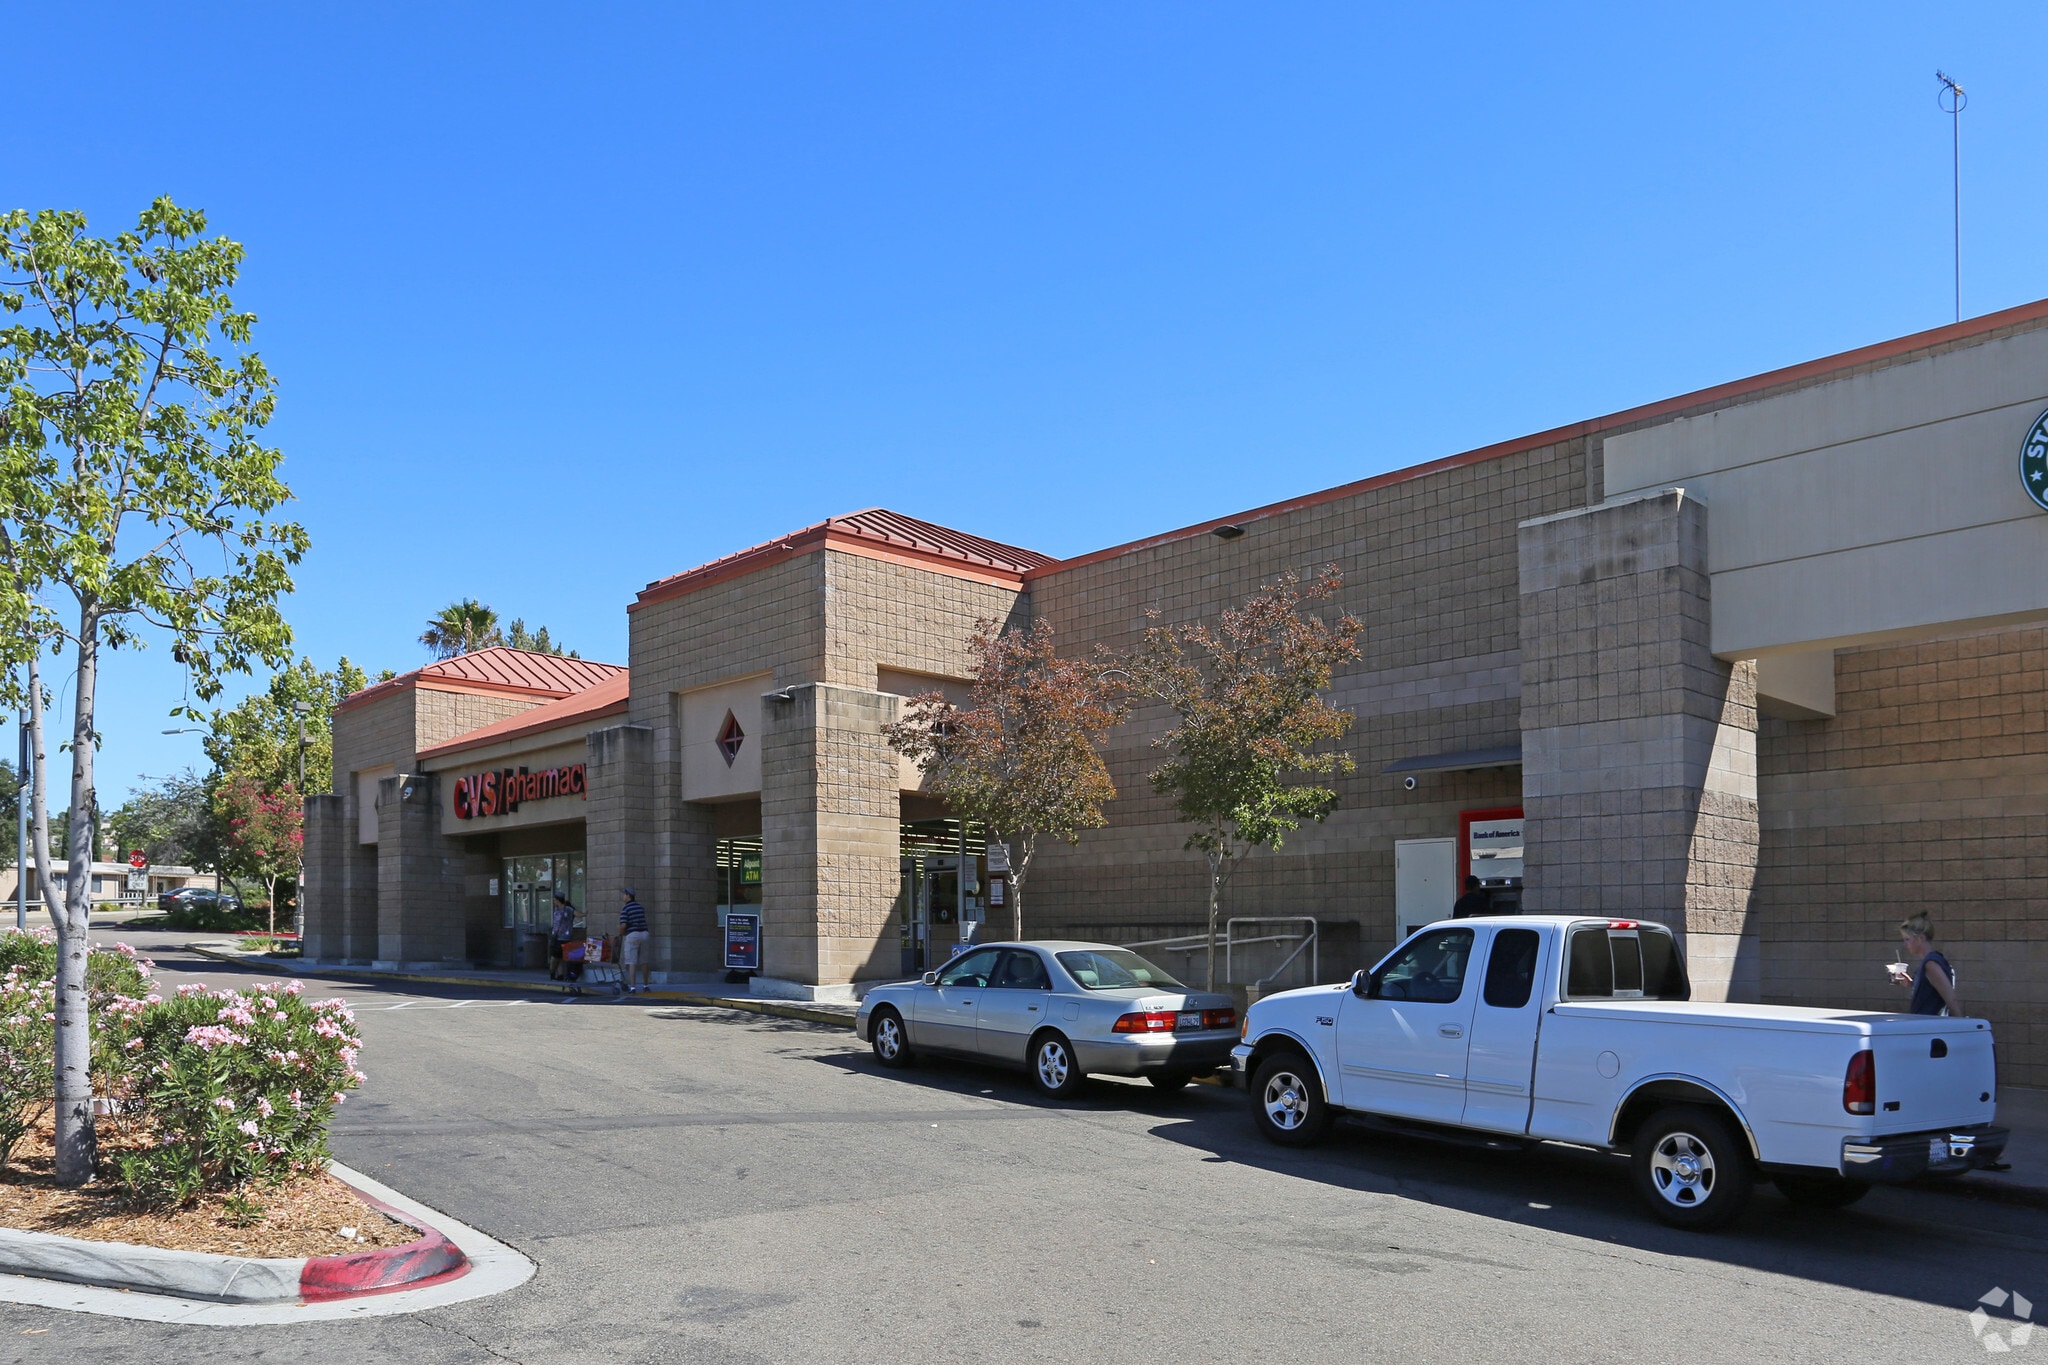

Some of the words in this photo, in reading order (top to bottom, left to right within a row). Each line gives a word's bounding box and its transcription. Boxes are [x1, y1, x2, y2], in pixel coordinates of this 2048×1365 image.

[1474, 831, 1488, 839] Bank
[1495, 830, 1520, 838] America
[745, 870, 759, 880] ATM
